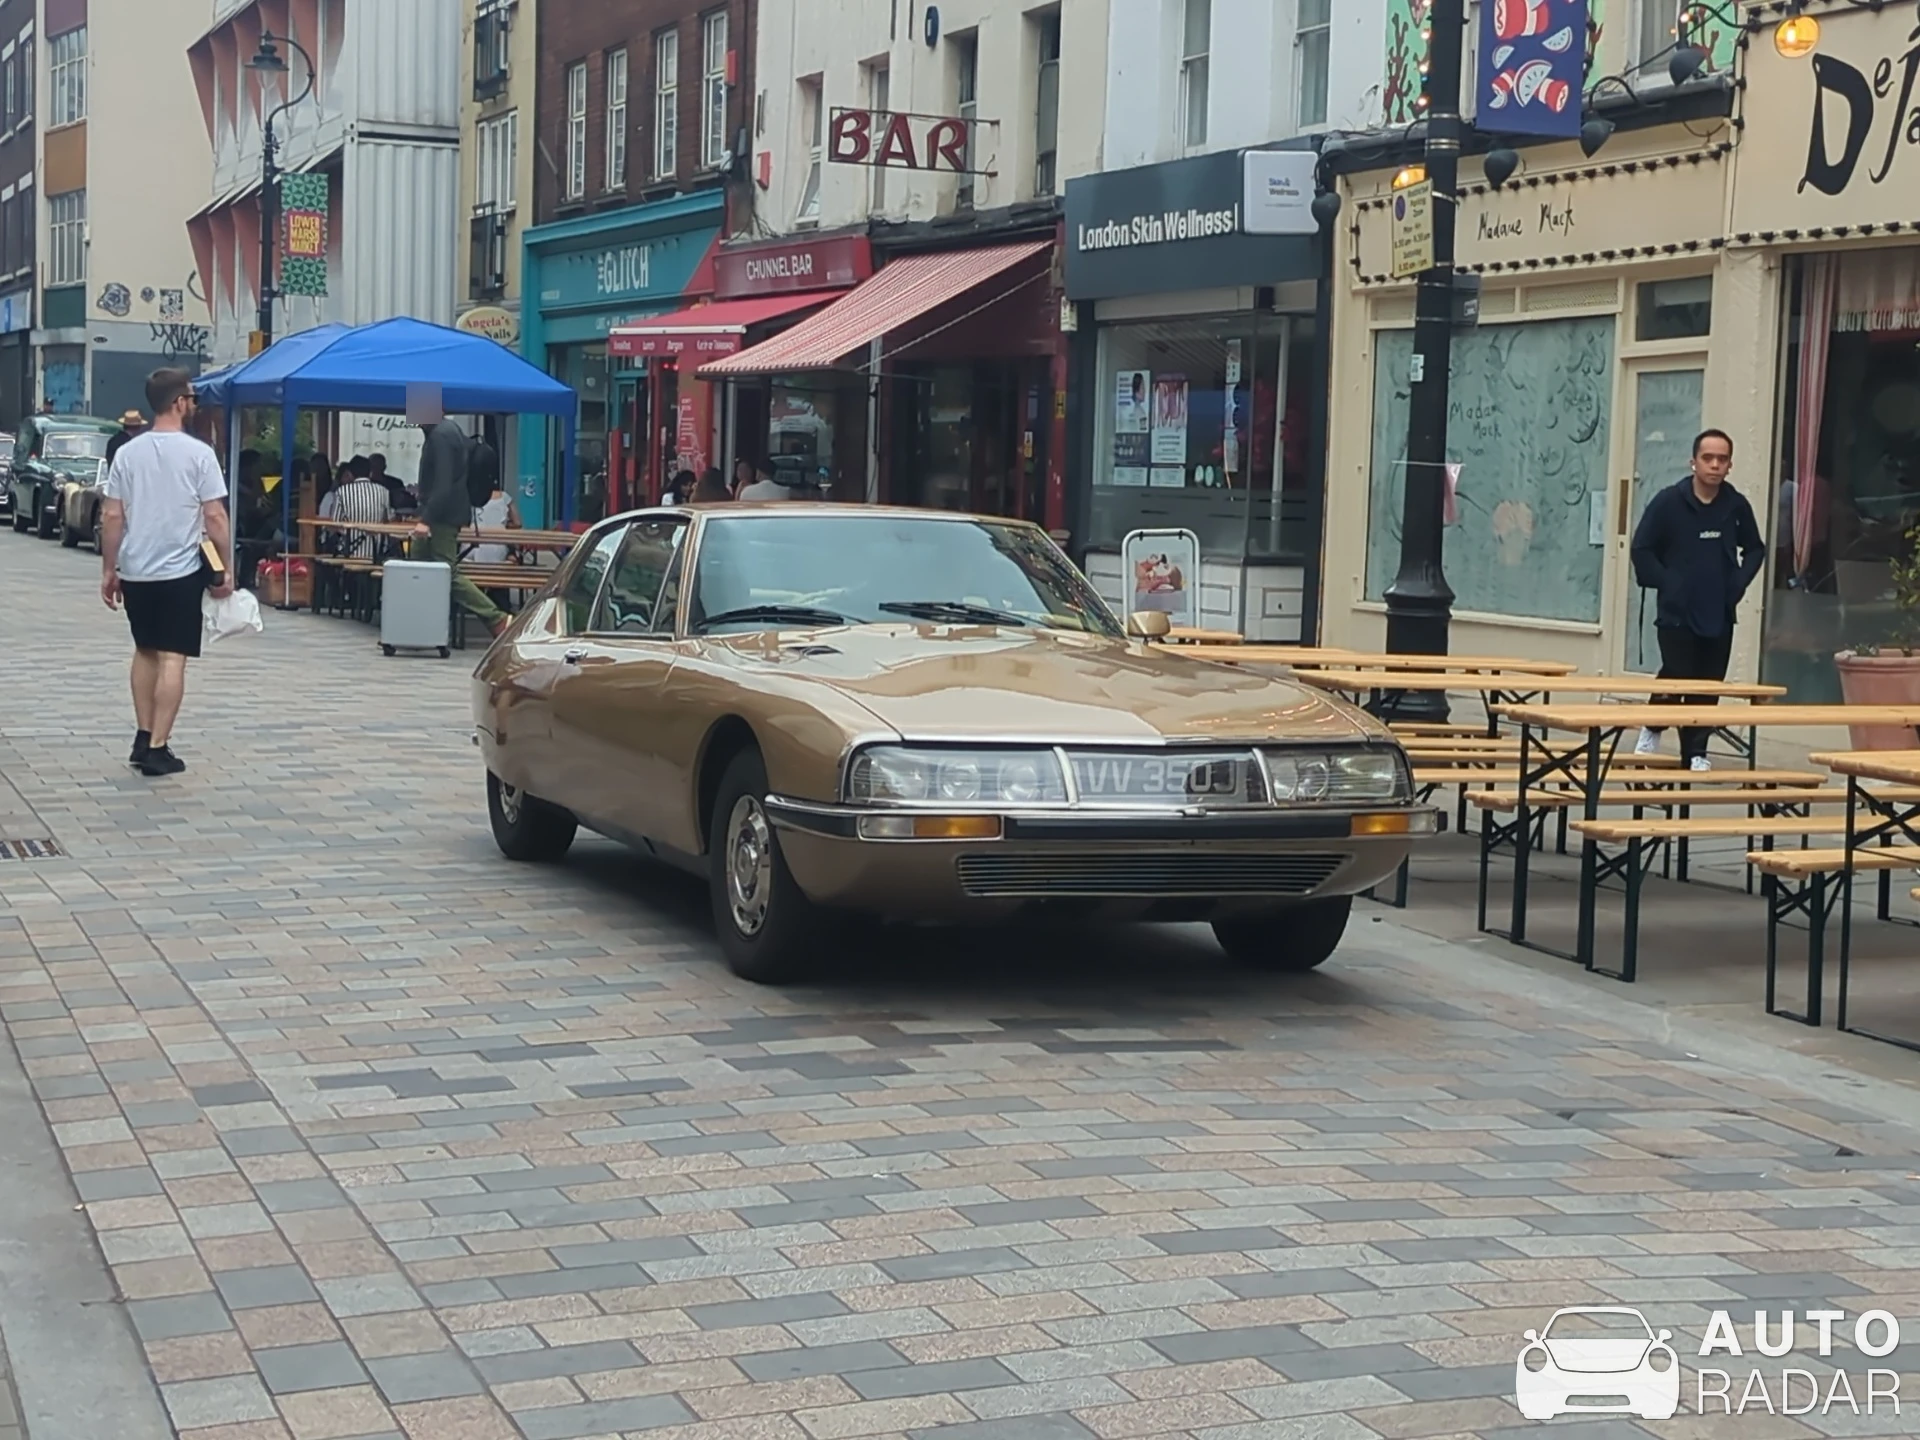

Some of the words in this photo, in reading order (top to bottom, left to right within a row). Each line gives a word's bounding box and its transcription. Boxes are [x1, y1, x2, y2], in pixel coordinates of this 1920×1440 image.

[831, 109, 968, 172] BAR
[289, 214, 320, 230] LOWER
[1078, 219, 1130, 251] London
[1131, 214, 1164, 245] Skin
[1164, 208, 1234, 241] Wellness
[1477, 211, 1523, 241] Madame
[604, 246, 649, 293] GLITCH
[745, 256, 792, 281] CHUNNEL
[791, 253, 813, 276] BAR
[463, 316, 510, 329] Angela's
